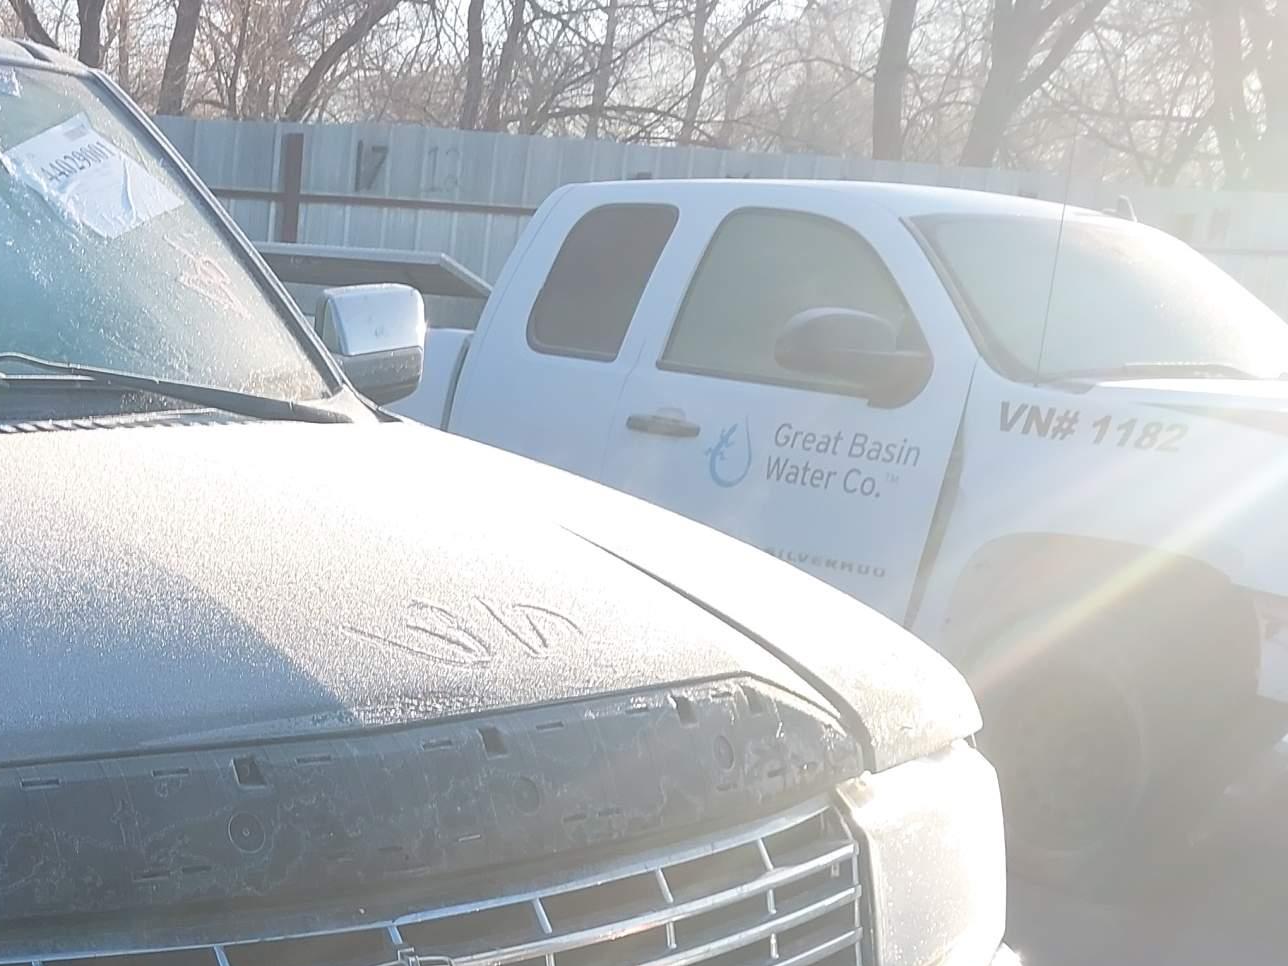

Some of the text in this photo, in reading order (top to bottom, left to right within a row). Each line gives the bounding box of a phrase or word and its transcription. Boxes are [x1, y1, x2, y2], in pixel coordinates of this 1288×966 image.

[40, 141, 117, 181] 44029001
[774, 422, 921, 467] Great Basin
[999, 400, 1190, 452] VN# 1182
[766, 455, 838, 489] Water
[843, 468, 881, 499] Co.
